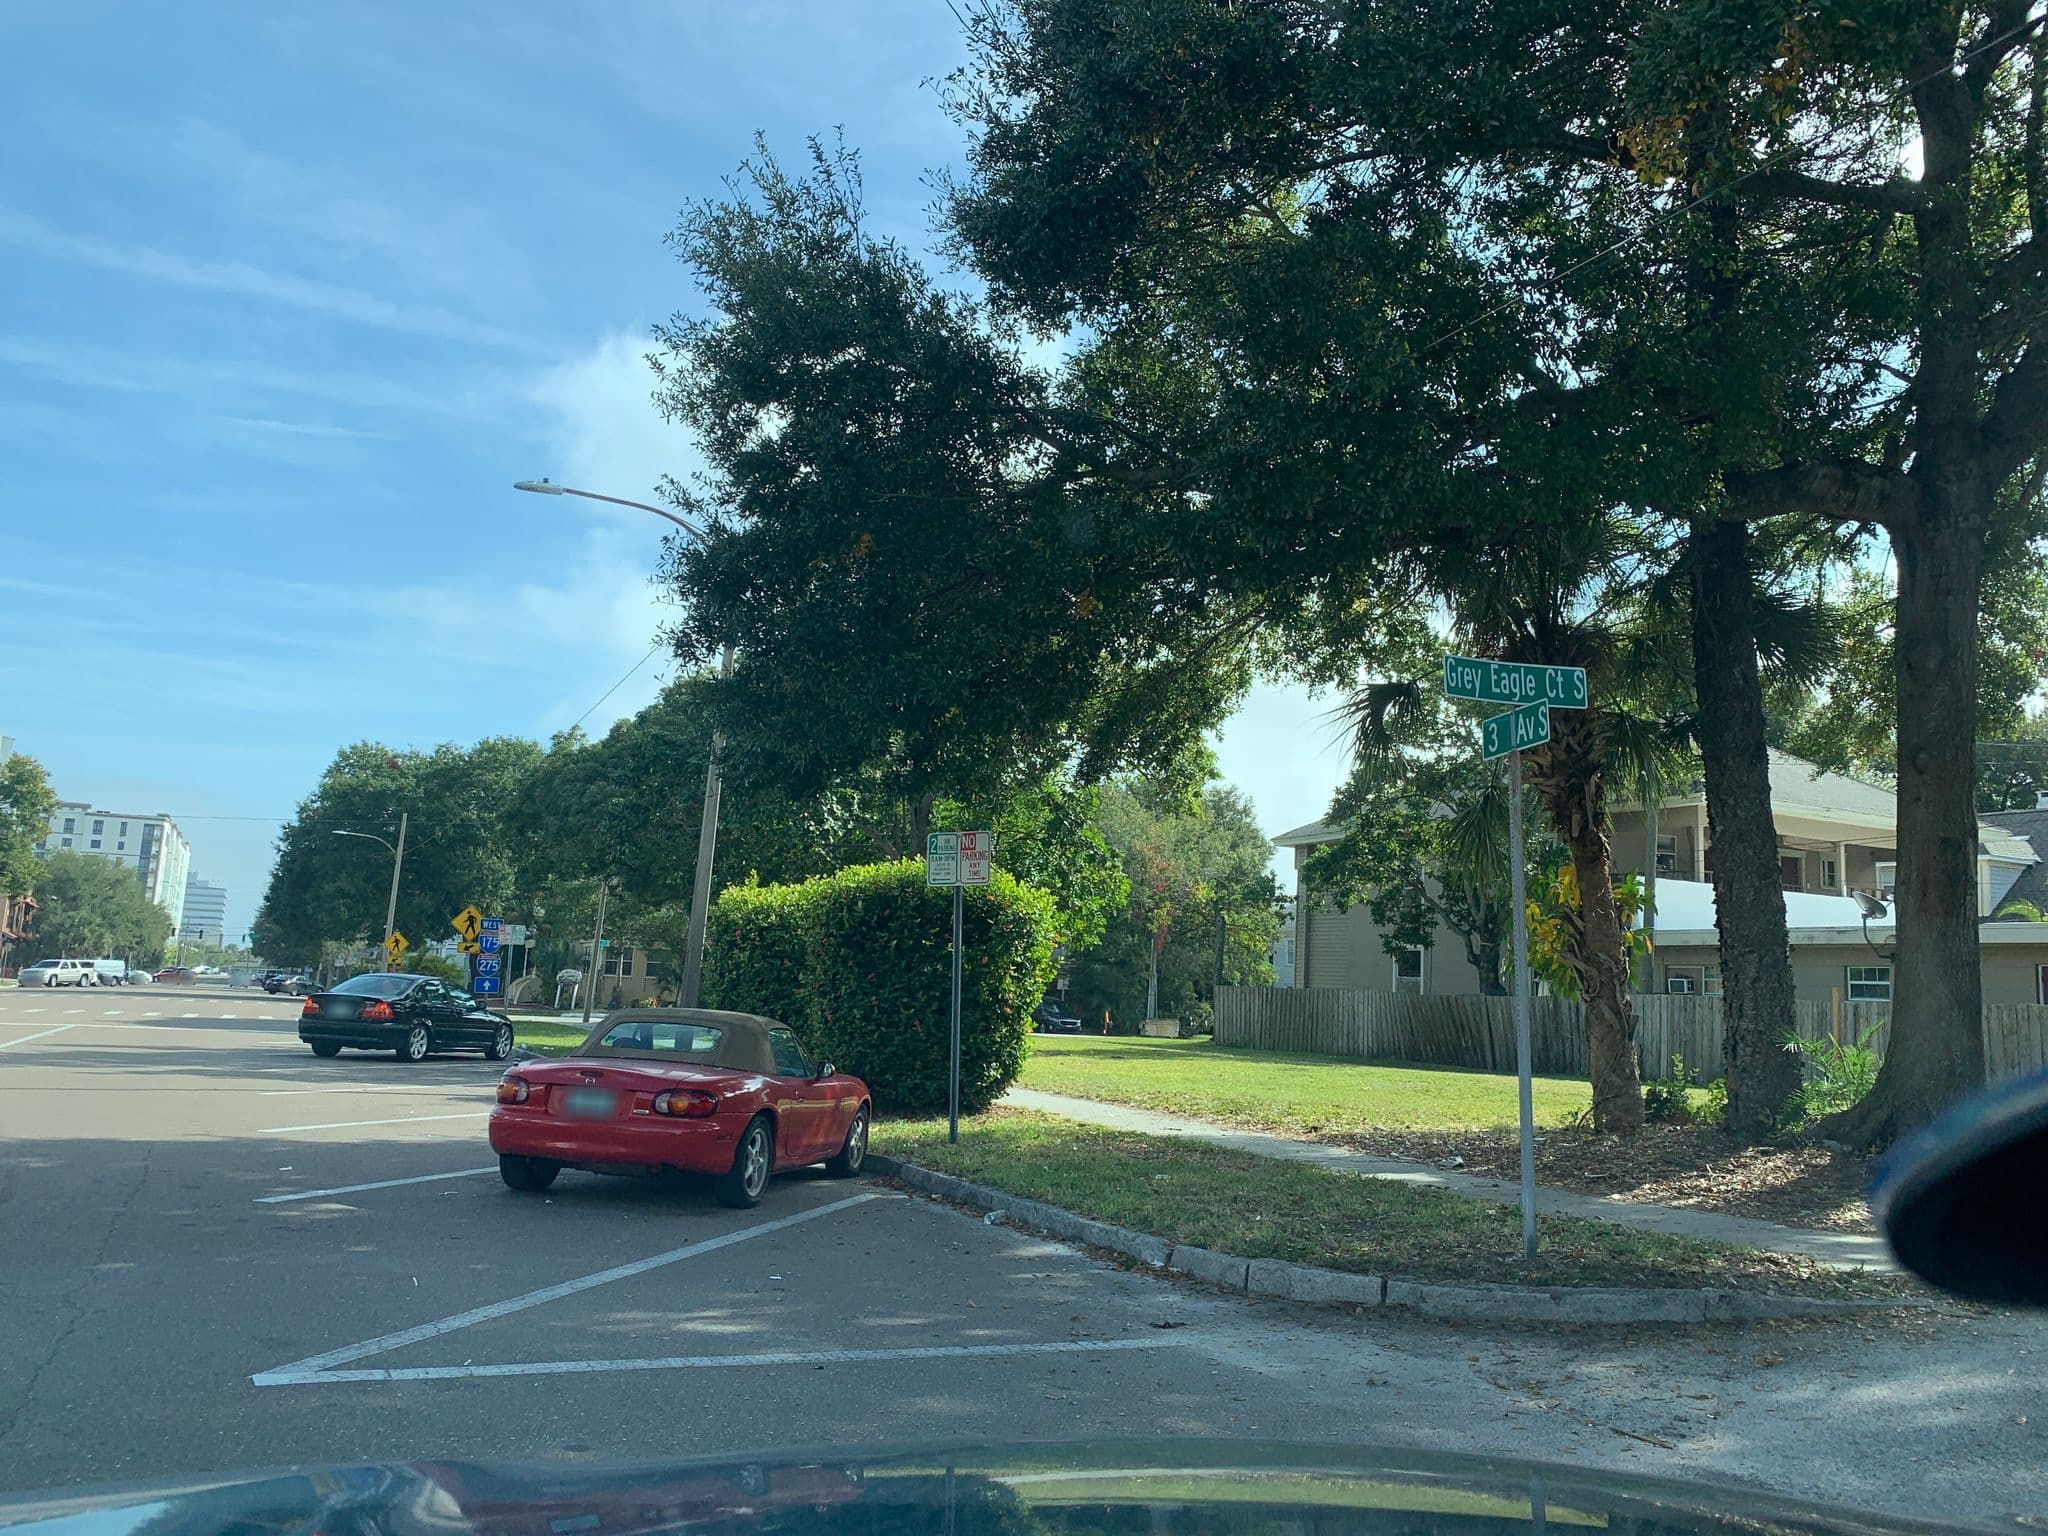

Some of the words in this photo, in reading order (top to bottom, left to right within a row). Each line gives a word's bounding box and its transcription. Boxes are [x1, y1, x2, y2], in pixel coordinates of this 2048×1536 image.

[1446, 657, 1482, 698] Grey
[1490, 664, 1536, 702] Eagle
[1545, 668, 1565, 699] Ct
[1573, 670, 1585, 700] S
[1488, 722, 1499, 752] 3
[1516, 713, 1535, 745] Av
[1538, 705, 1548, 737] S
[930, 838, 937, 853] 2
[962, 835, 976, 849] NO
[961, 851, 988, 861] PARKING
[482, 936, 500, 948] 175
[480, 960, 499, 971] 275
